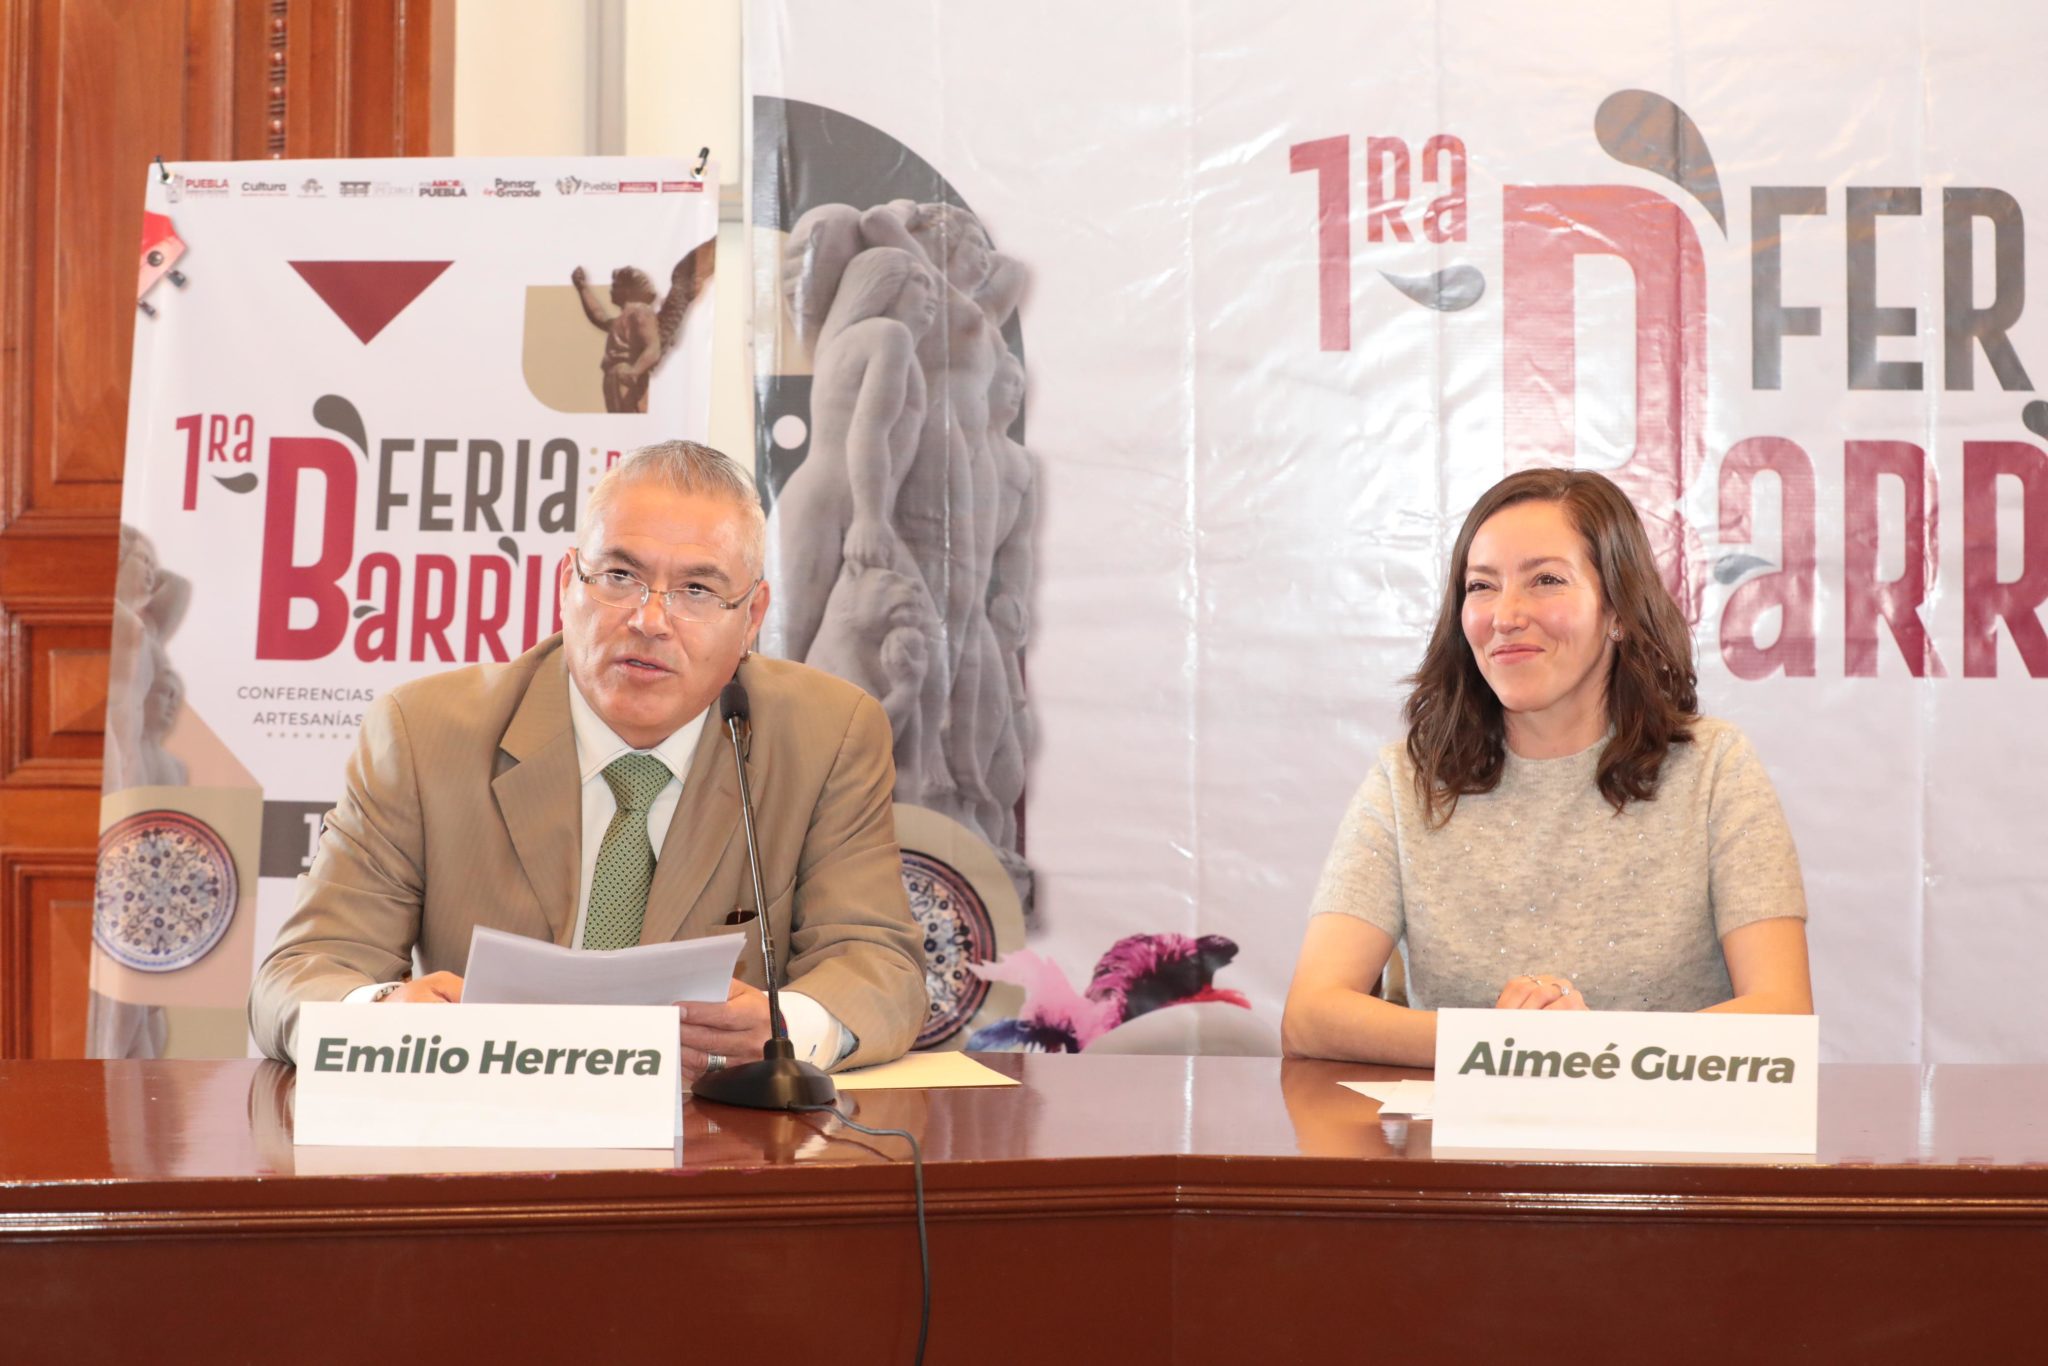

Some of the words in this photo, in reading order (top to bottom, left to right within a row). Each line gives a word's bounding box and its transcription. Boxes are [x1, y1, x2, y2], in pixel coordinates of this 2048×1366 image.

[242, 182, 287, 191] Cultura
[237, 686, 374, 702] CONFERENCIAS
[252, 711, 364, 727] ARTESANÍAS
[314, 1034, 470, 1074] Emilio
[478, 1040, 662, 1076] Herrera
[1458, 1037, 1620, 1080] Aimeé
[1631, 1045, 1796, 1084] Guerra
